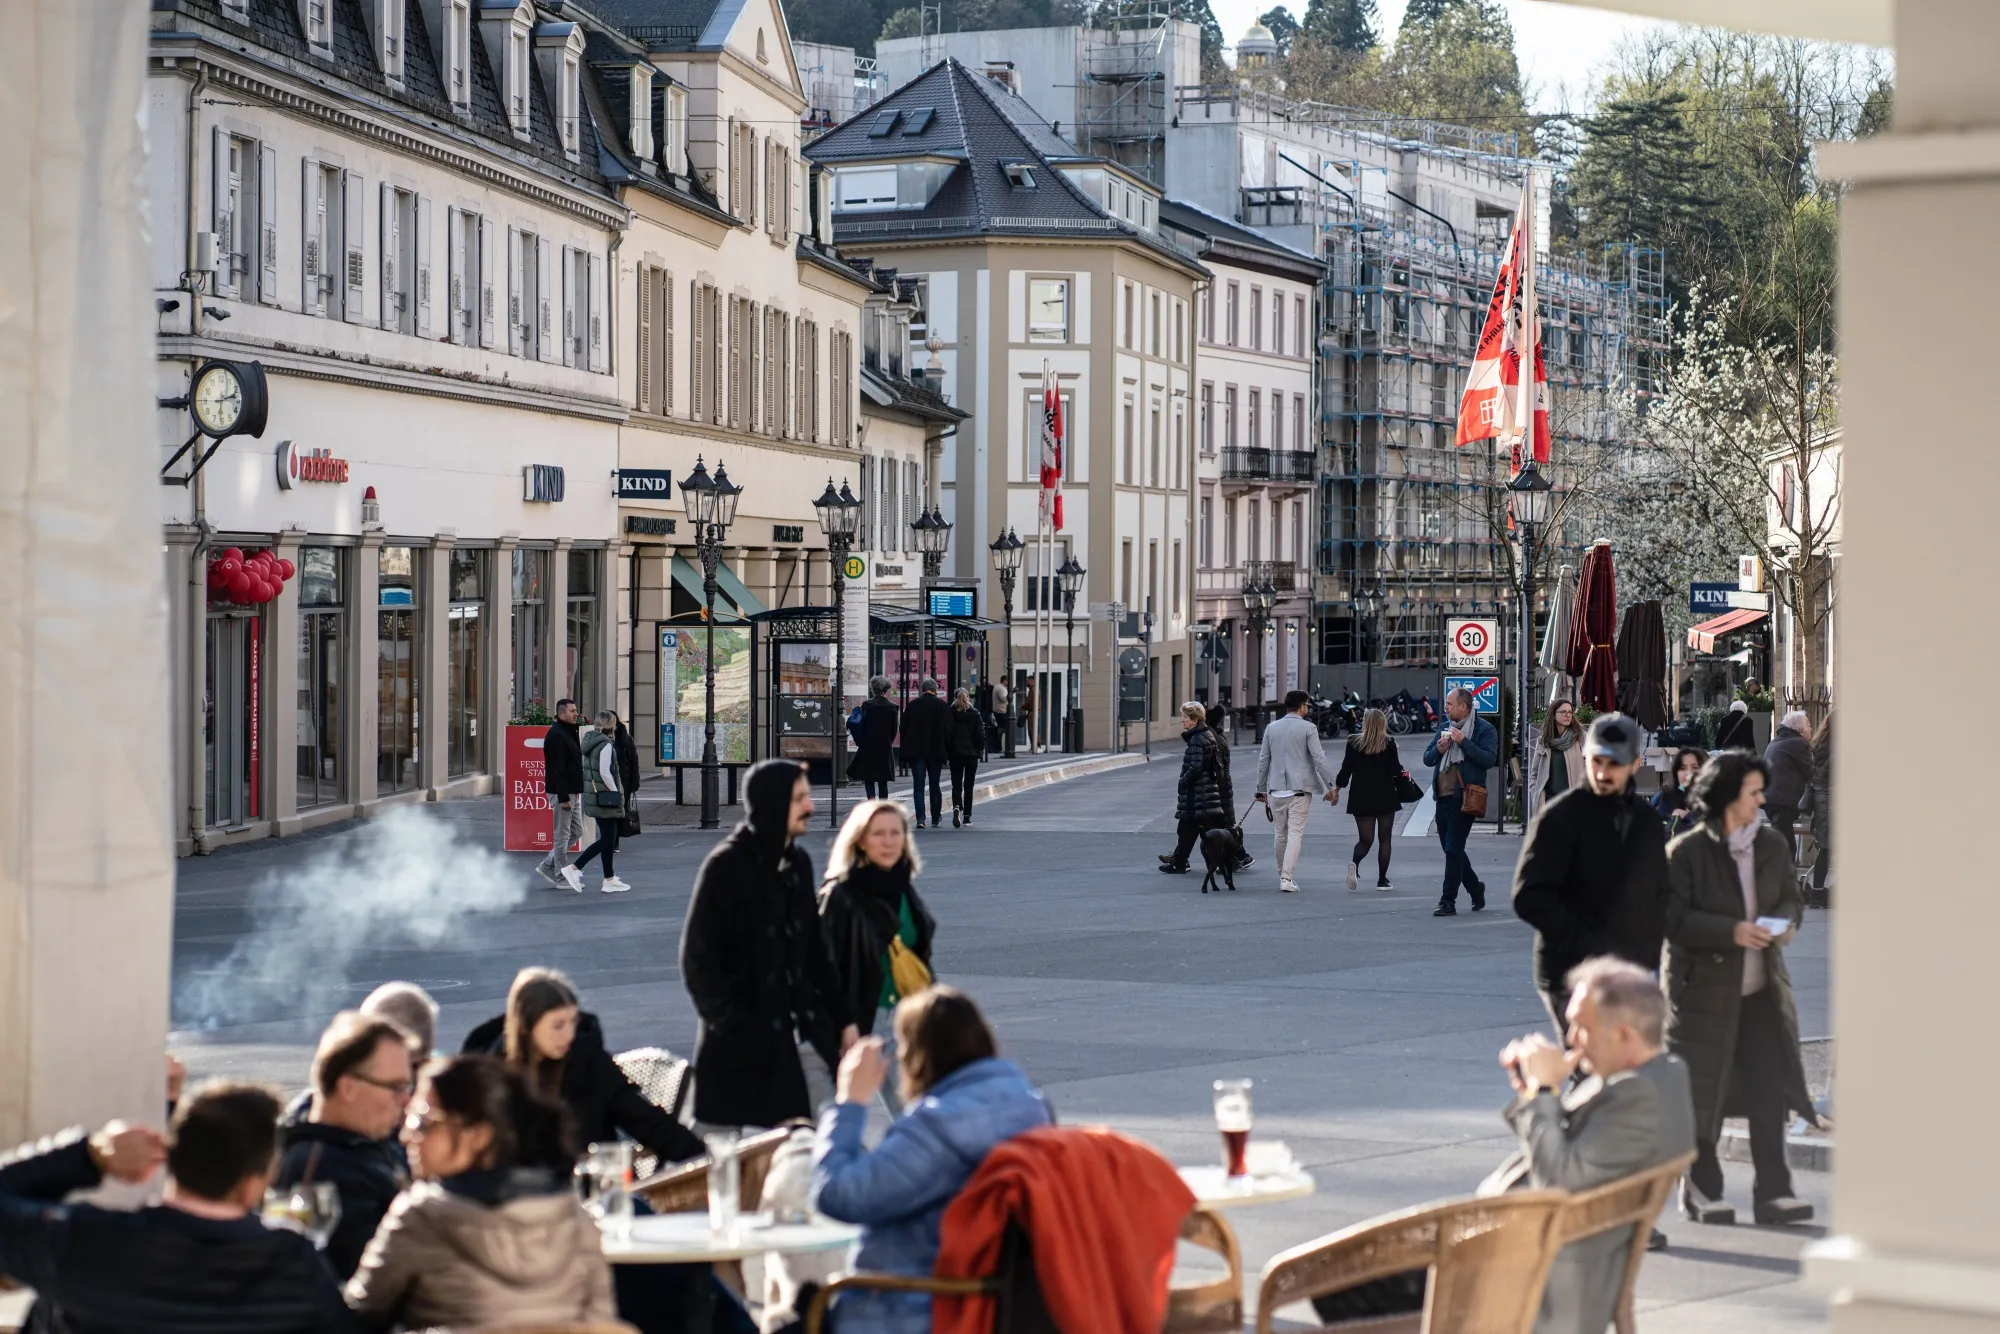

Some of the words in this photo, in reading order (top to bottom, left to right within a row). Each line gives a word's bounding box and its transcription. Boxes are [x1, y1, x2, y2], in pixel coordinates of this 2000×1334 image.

[300, 448, 349, 483] vodafone
[533, 464, 565, 502] KIND
[621, 477, 667, 491] KIND
[848, 562, 859, 574] H
[1462, 632, 1482, 647] 30
[1459, 658, 1484, 666] ZONE
[520, 760, 545, 769] FESTS
